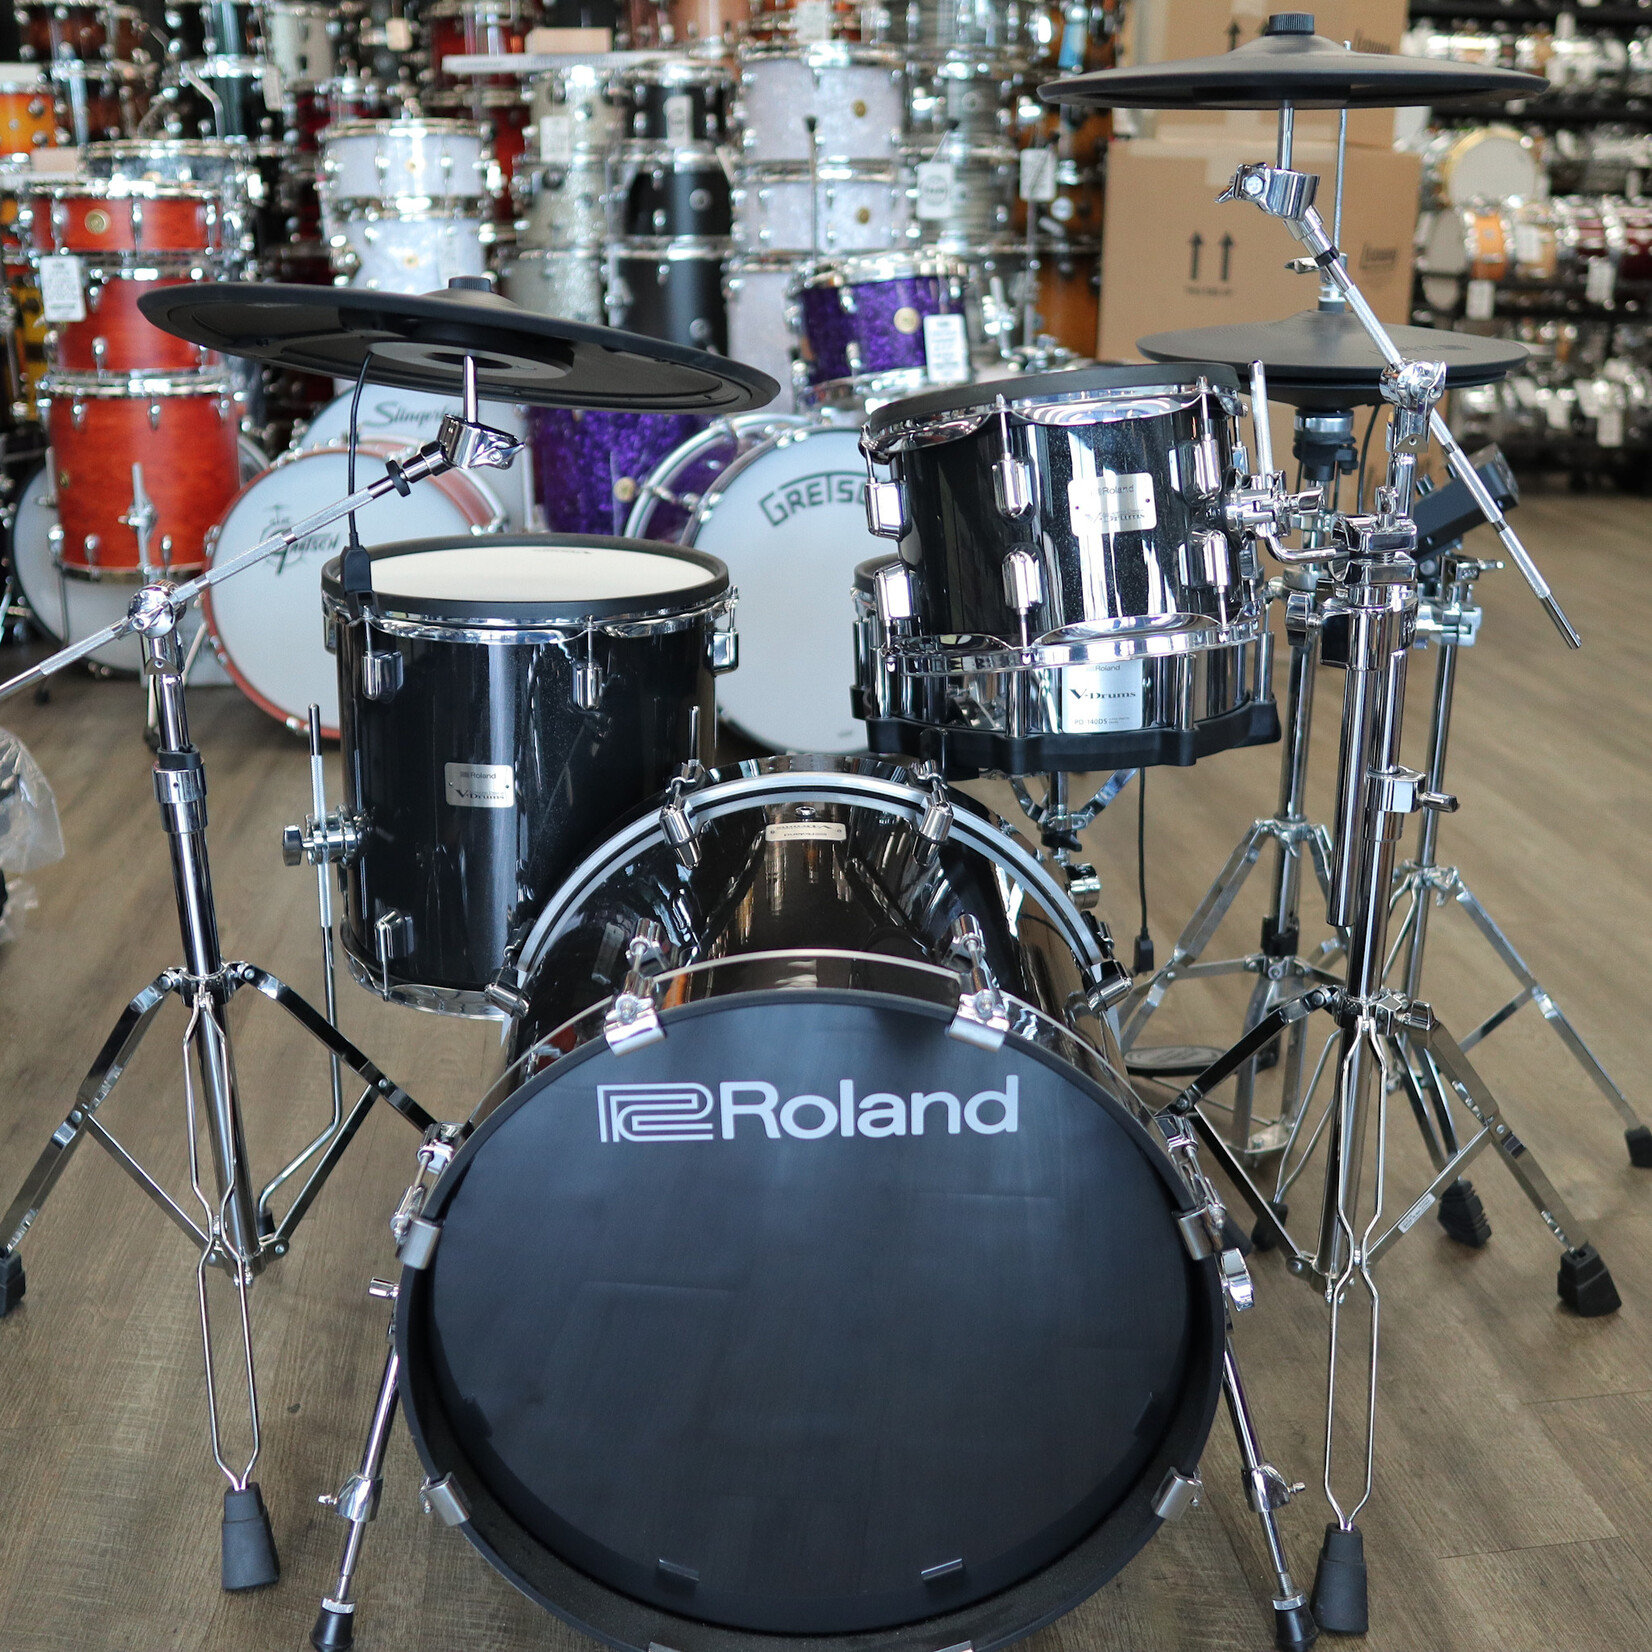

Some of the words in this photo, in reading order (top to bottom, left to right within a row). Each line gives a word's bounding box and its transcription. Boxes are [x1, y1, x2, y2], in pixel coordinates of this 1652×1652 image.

[361, 400, 464, 429] Slingerl
[1102, 483, 1135, 495] Roland
[759, 470, 867, 526] GRETSC
[1069, 689, 1136, 700] V-Drums
[470, 771, 497, 779] Roland
[455, 789, 505, 800] V-Drums
[719, 1074, 1019, 1140] Roland
